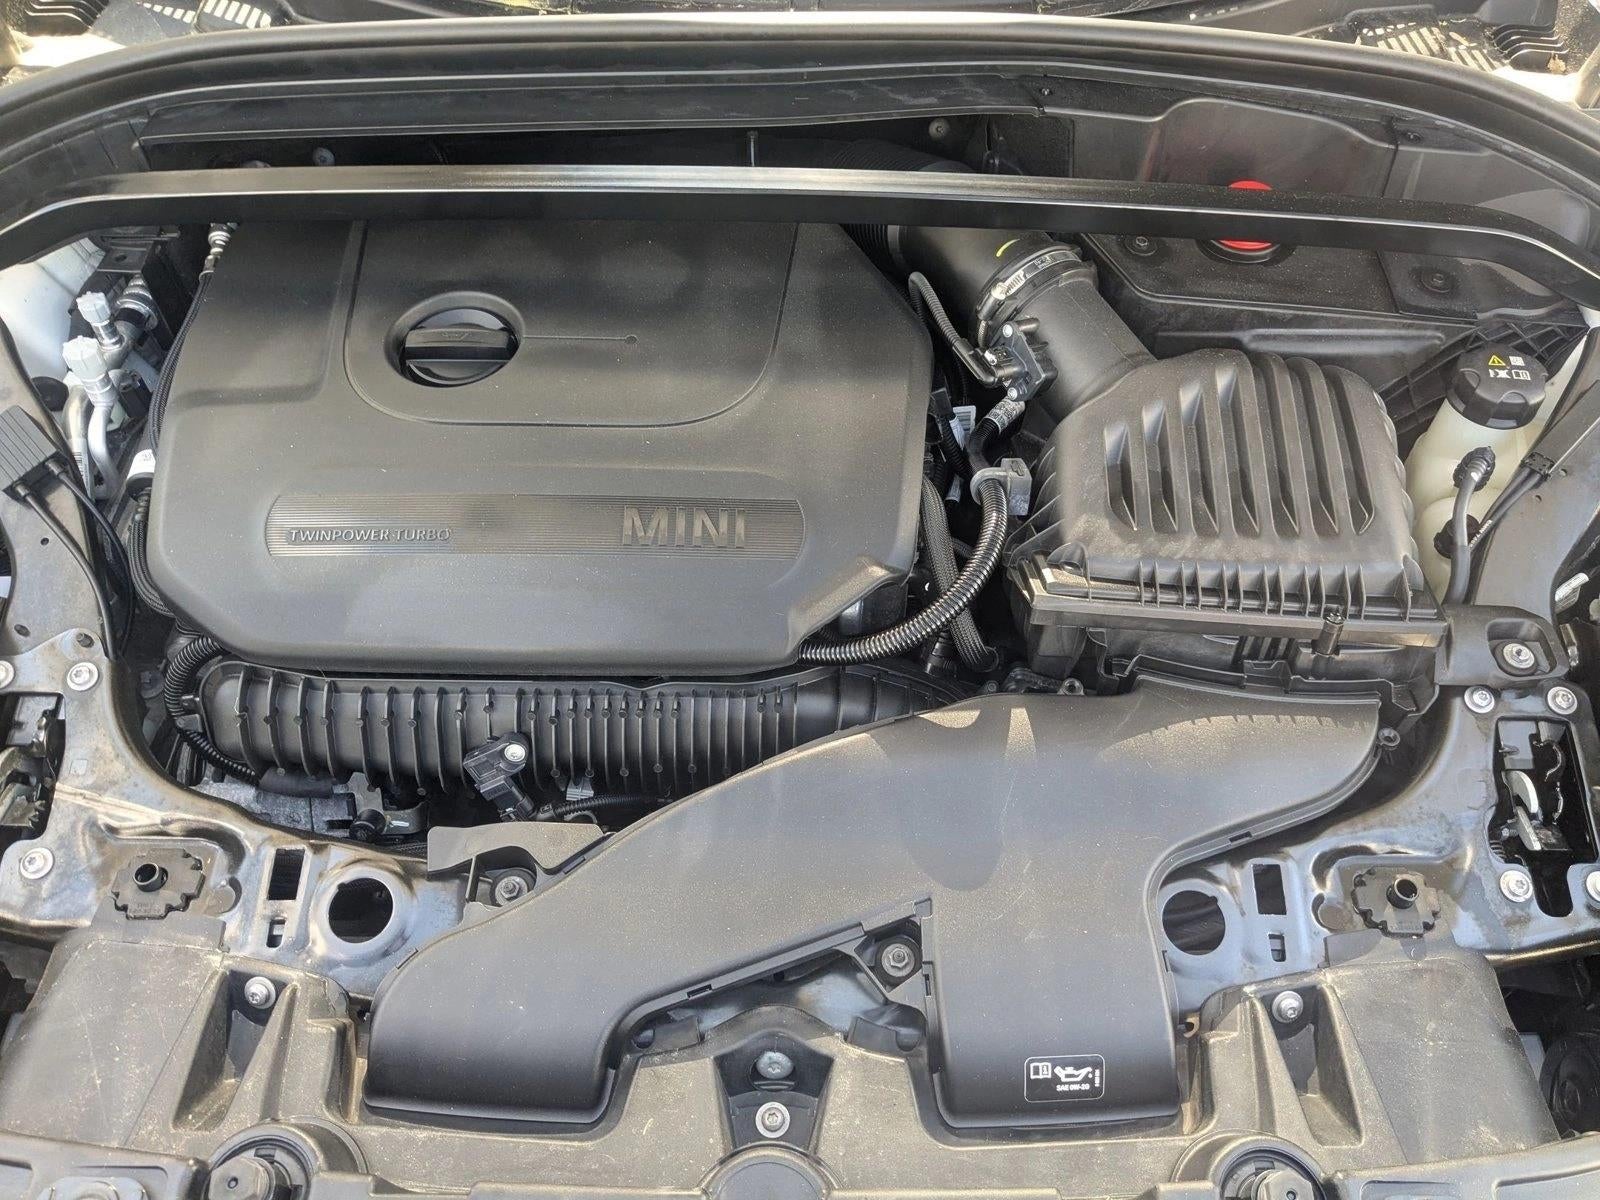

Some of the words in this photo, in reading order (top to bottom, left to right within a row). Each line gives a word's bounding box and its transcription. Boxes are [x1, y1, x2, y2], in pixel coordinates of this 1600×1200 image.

[289, 528, 391, 543] TWINPOWER
[395, 527, 452, 542] TURBO
[622, 505, 745, 548] MINI
